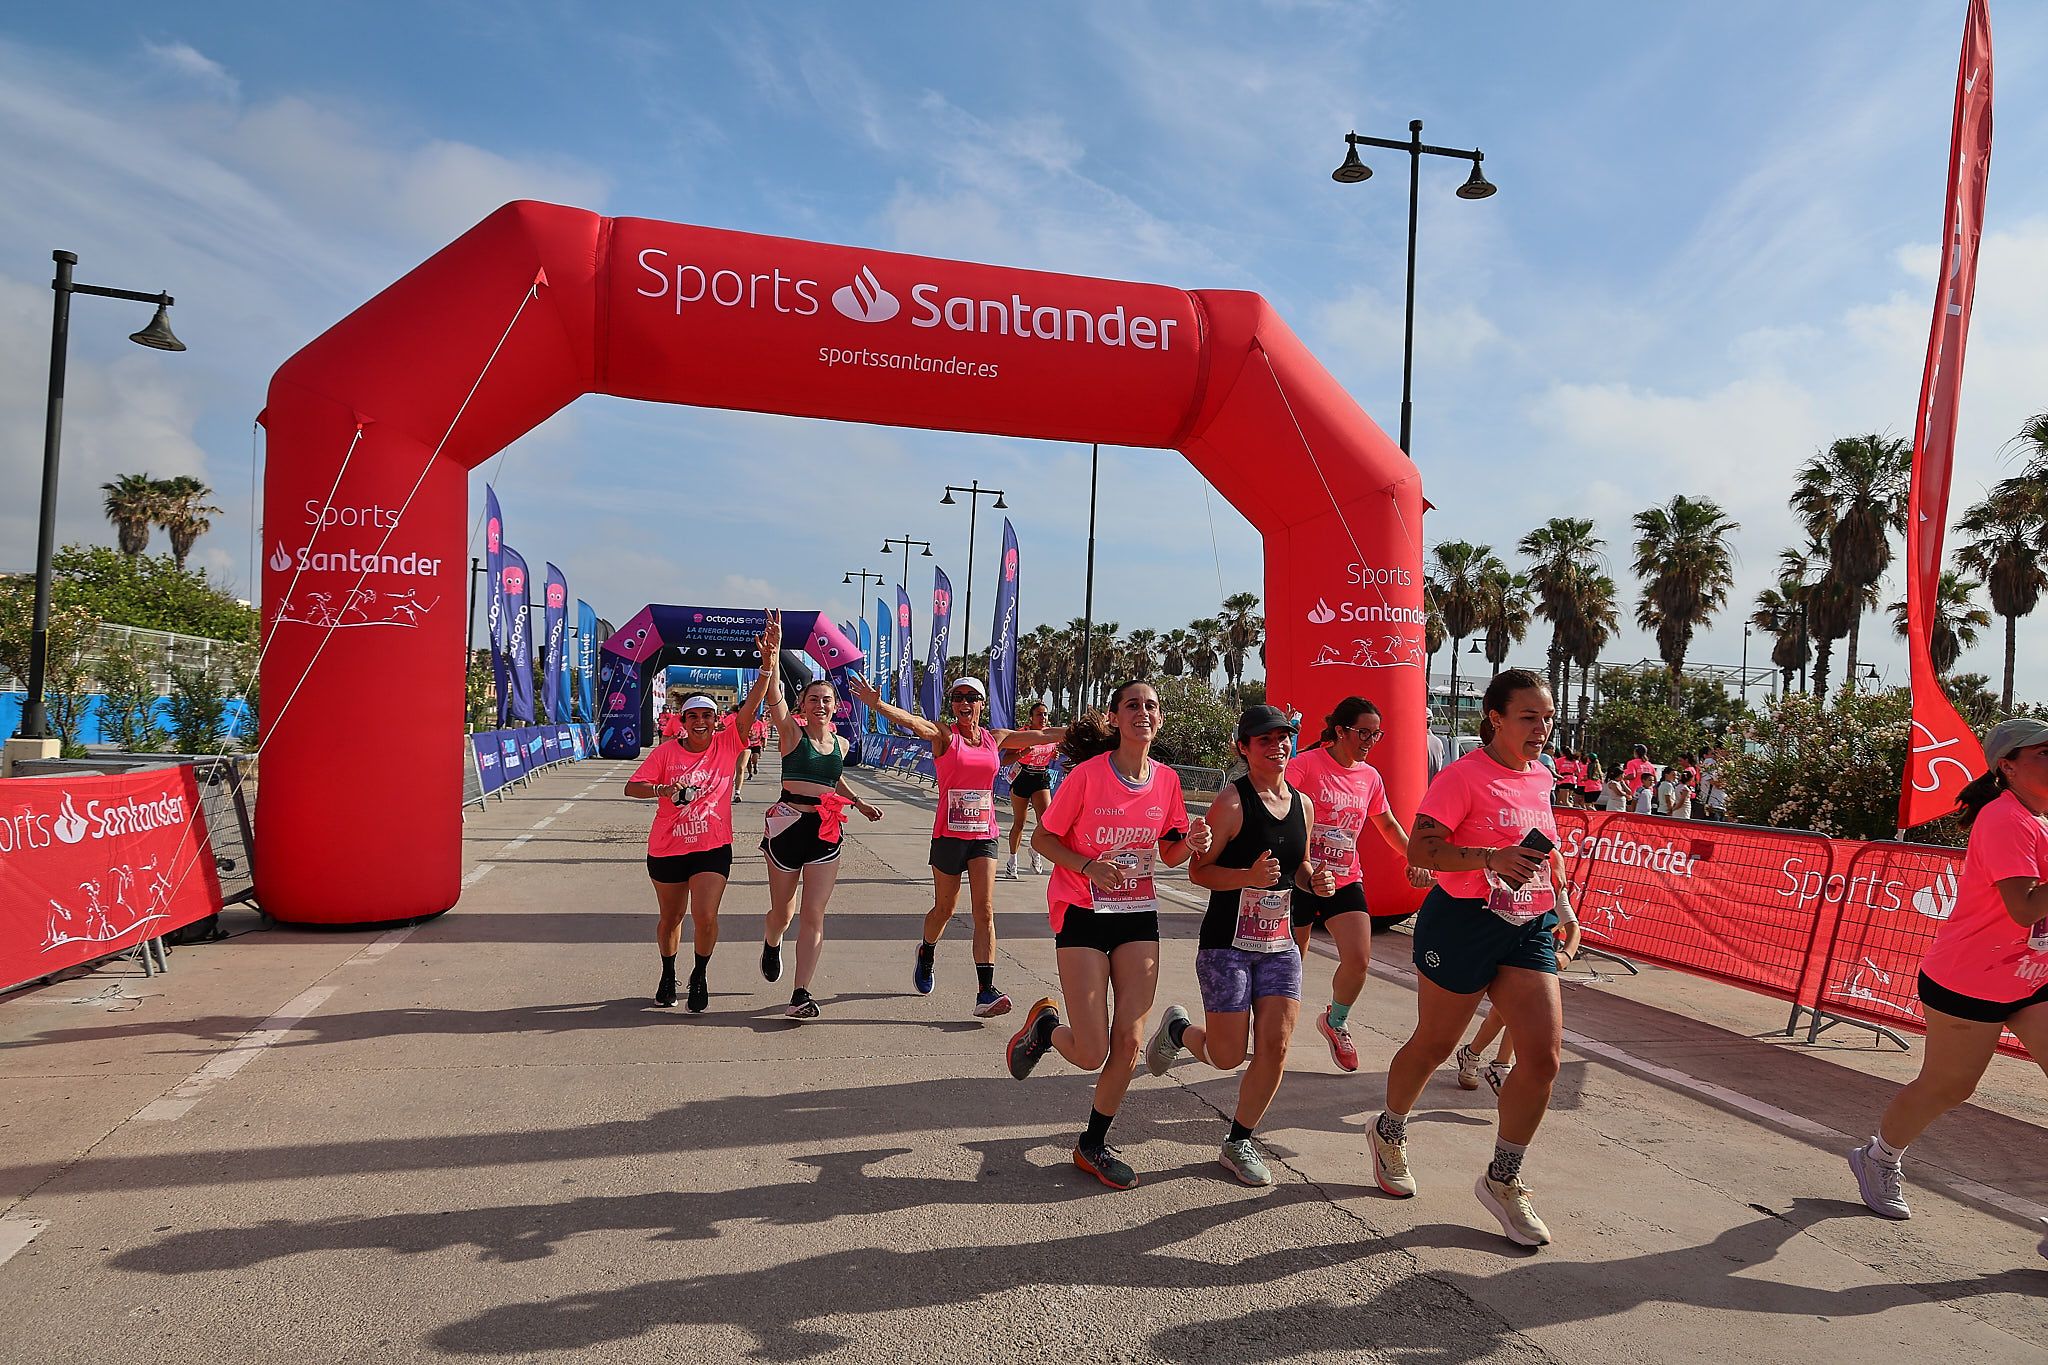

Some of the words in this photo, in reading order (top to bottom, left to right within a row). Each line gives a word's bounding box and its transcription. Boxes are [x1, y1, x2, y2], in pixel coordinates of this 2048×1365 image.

[637, 248, 819, 315] Sports
[911, 283, 1177, 351] Santander
[818, 347, 998, 378] sportssantander.es
[304, 500, 399, 532] Sports
[296, 547, 442, 576] Santander
[1347, 563, 1411, 589] Sports
[706, 615, 745, 625] octopus
[676, 646, 762, 658] VOLVO
[87, 792, 185, 839] Santander
[963, 808, 980, 816] 016
[1095, 807, 1125, 816] OYSHO
[673, 820, 709, 837] MUJER
[1095, 826, 1157, 845] CARRERA
[1323, 846, 1344, 858] 016
[1562, 828, 1701, 878] Santander
[1777, 858, 1904, 911] Sports
[1513, 889, 1532, 902] 016
[1259, 919, 1280, 930] 016
